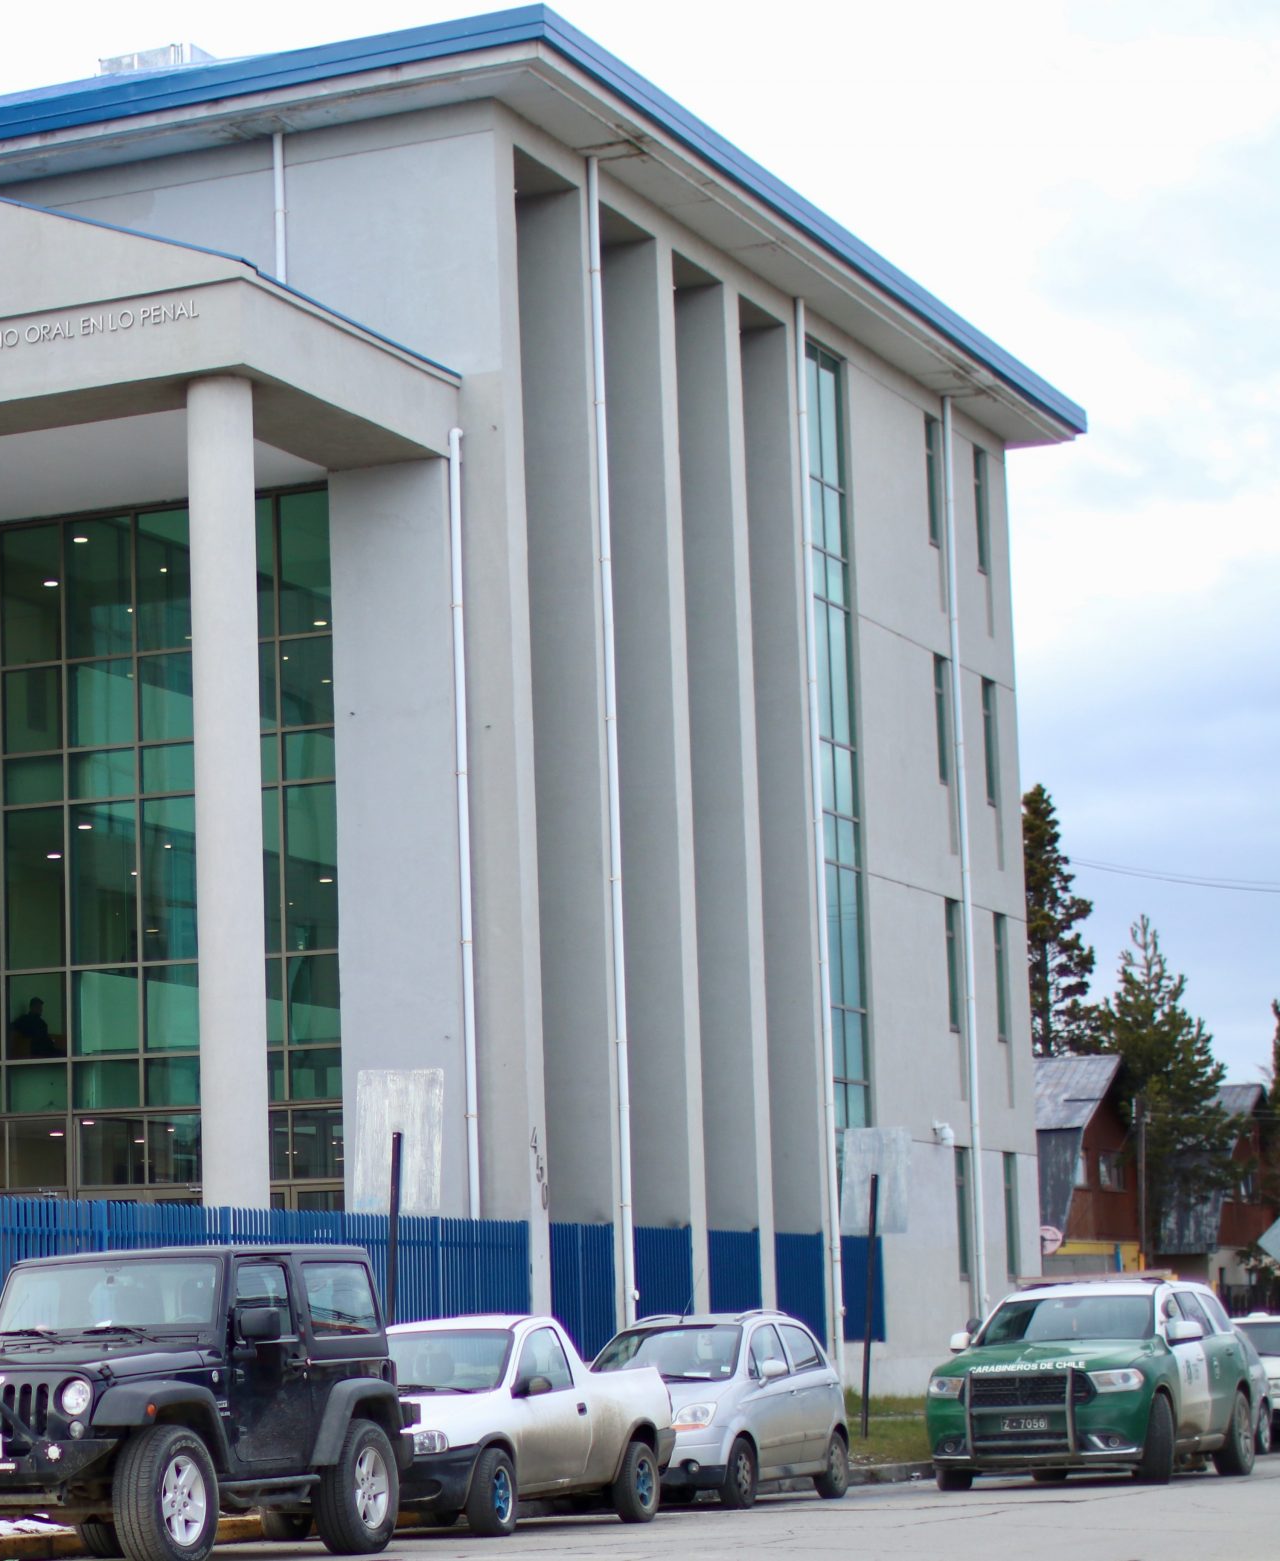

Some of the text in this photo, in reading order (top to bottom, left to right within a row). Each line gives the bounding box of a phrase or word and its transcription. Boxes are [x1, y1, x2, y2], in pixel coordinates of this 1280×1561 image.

[24, 319, 74, 344] ORAL
[80, 314, 104, 336] EN
[108, 309, 135, 331] LO
[140, 299, 200, 328] PENAL
[968, 1361, 1086, 1374] CARABINEROS DE CHILE
